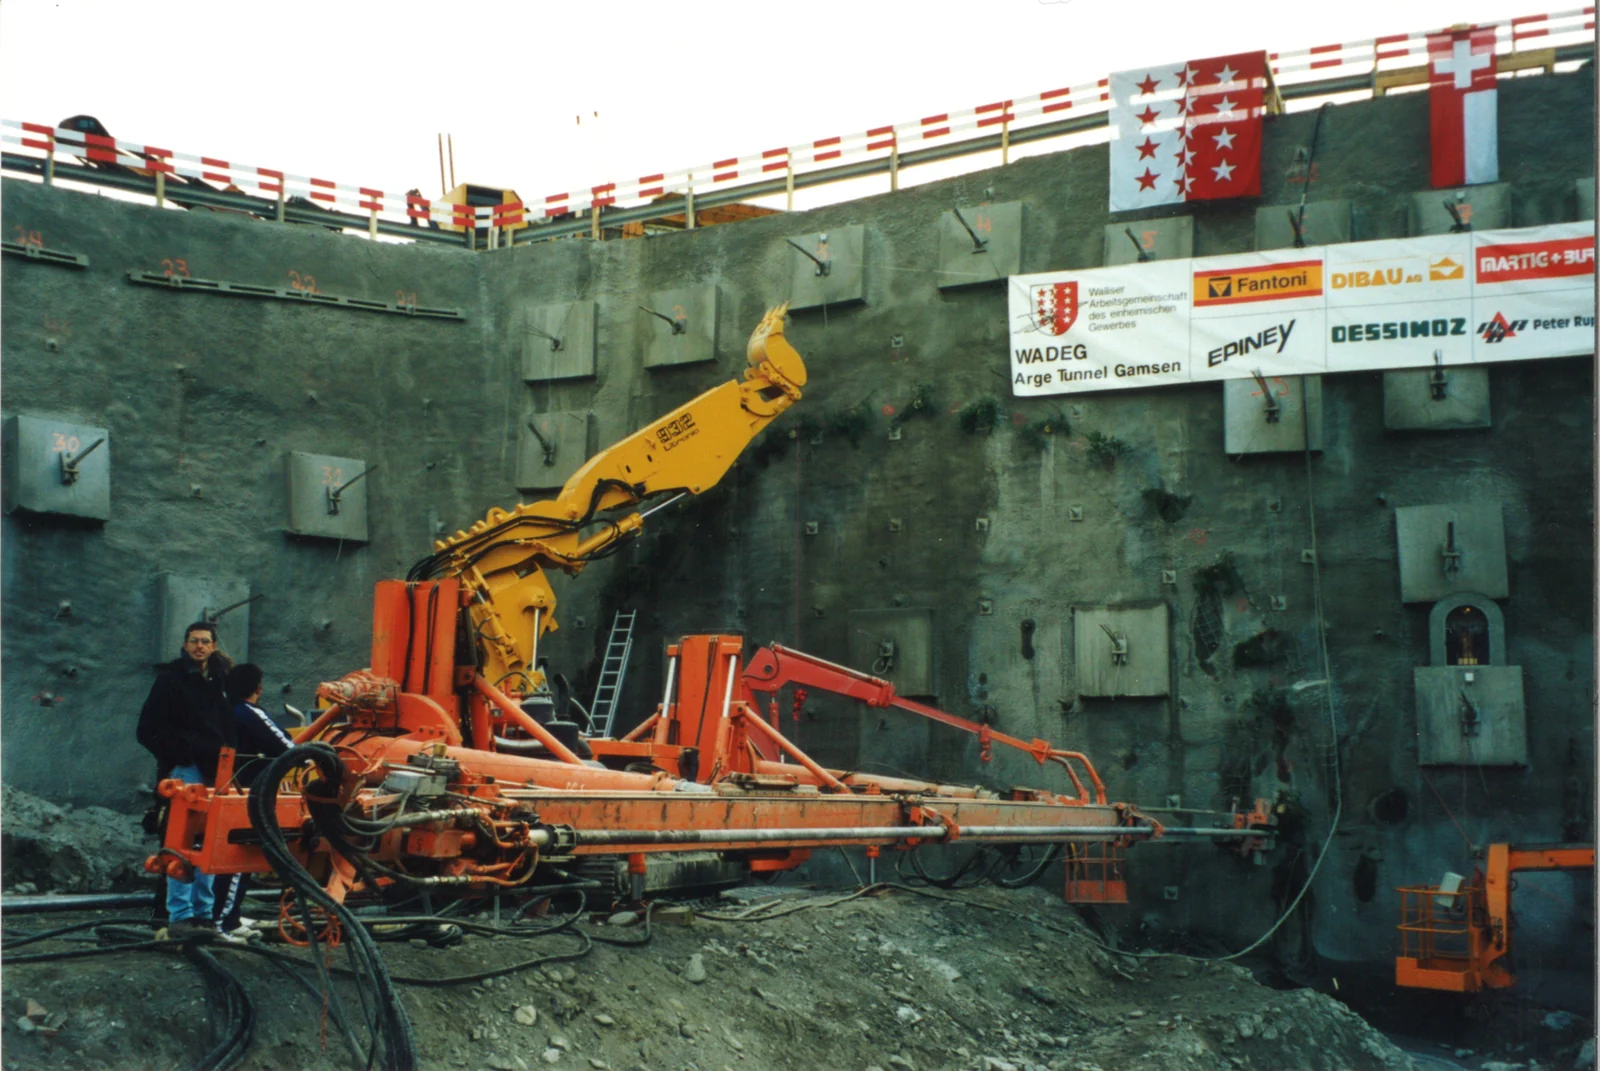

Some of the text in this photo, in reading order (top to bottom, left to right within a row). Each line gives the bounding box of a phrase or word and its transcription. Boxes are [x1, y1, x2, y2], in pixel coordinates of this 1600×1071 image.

[1143, 231, 1157, 249] 5
[1480, 251, 1548, 273] MARTIG
[1237, 271, 1308, 293] Fantoni
[1331, 267, 1423, 289] DIBAU AG
[1088, 286, 1125, 297] Walliser
[1089, 292, 1188, 309] Arbeitsgemeinschaft
[1088, 304, 1177, 321] des einheimischen
[1088, 320, 1137, 333] Gewerbes
[1331, 317, 1467, 343] DESSIMOZ
[1533, 318, 1570, 330] Peter
[1207, 318, 1296, 368] EPINEY
[1015, 344, 1088, 364] WADEG
[1014, 361, 1181, 388] Arge Tunnel Gamsen
[656, 412, 696, 444] 932
[51, 432, 80, 453] 30
